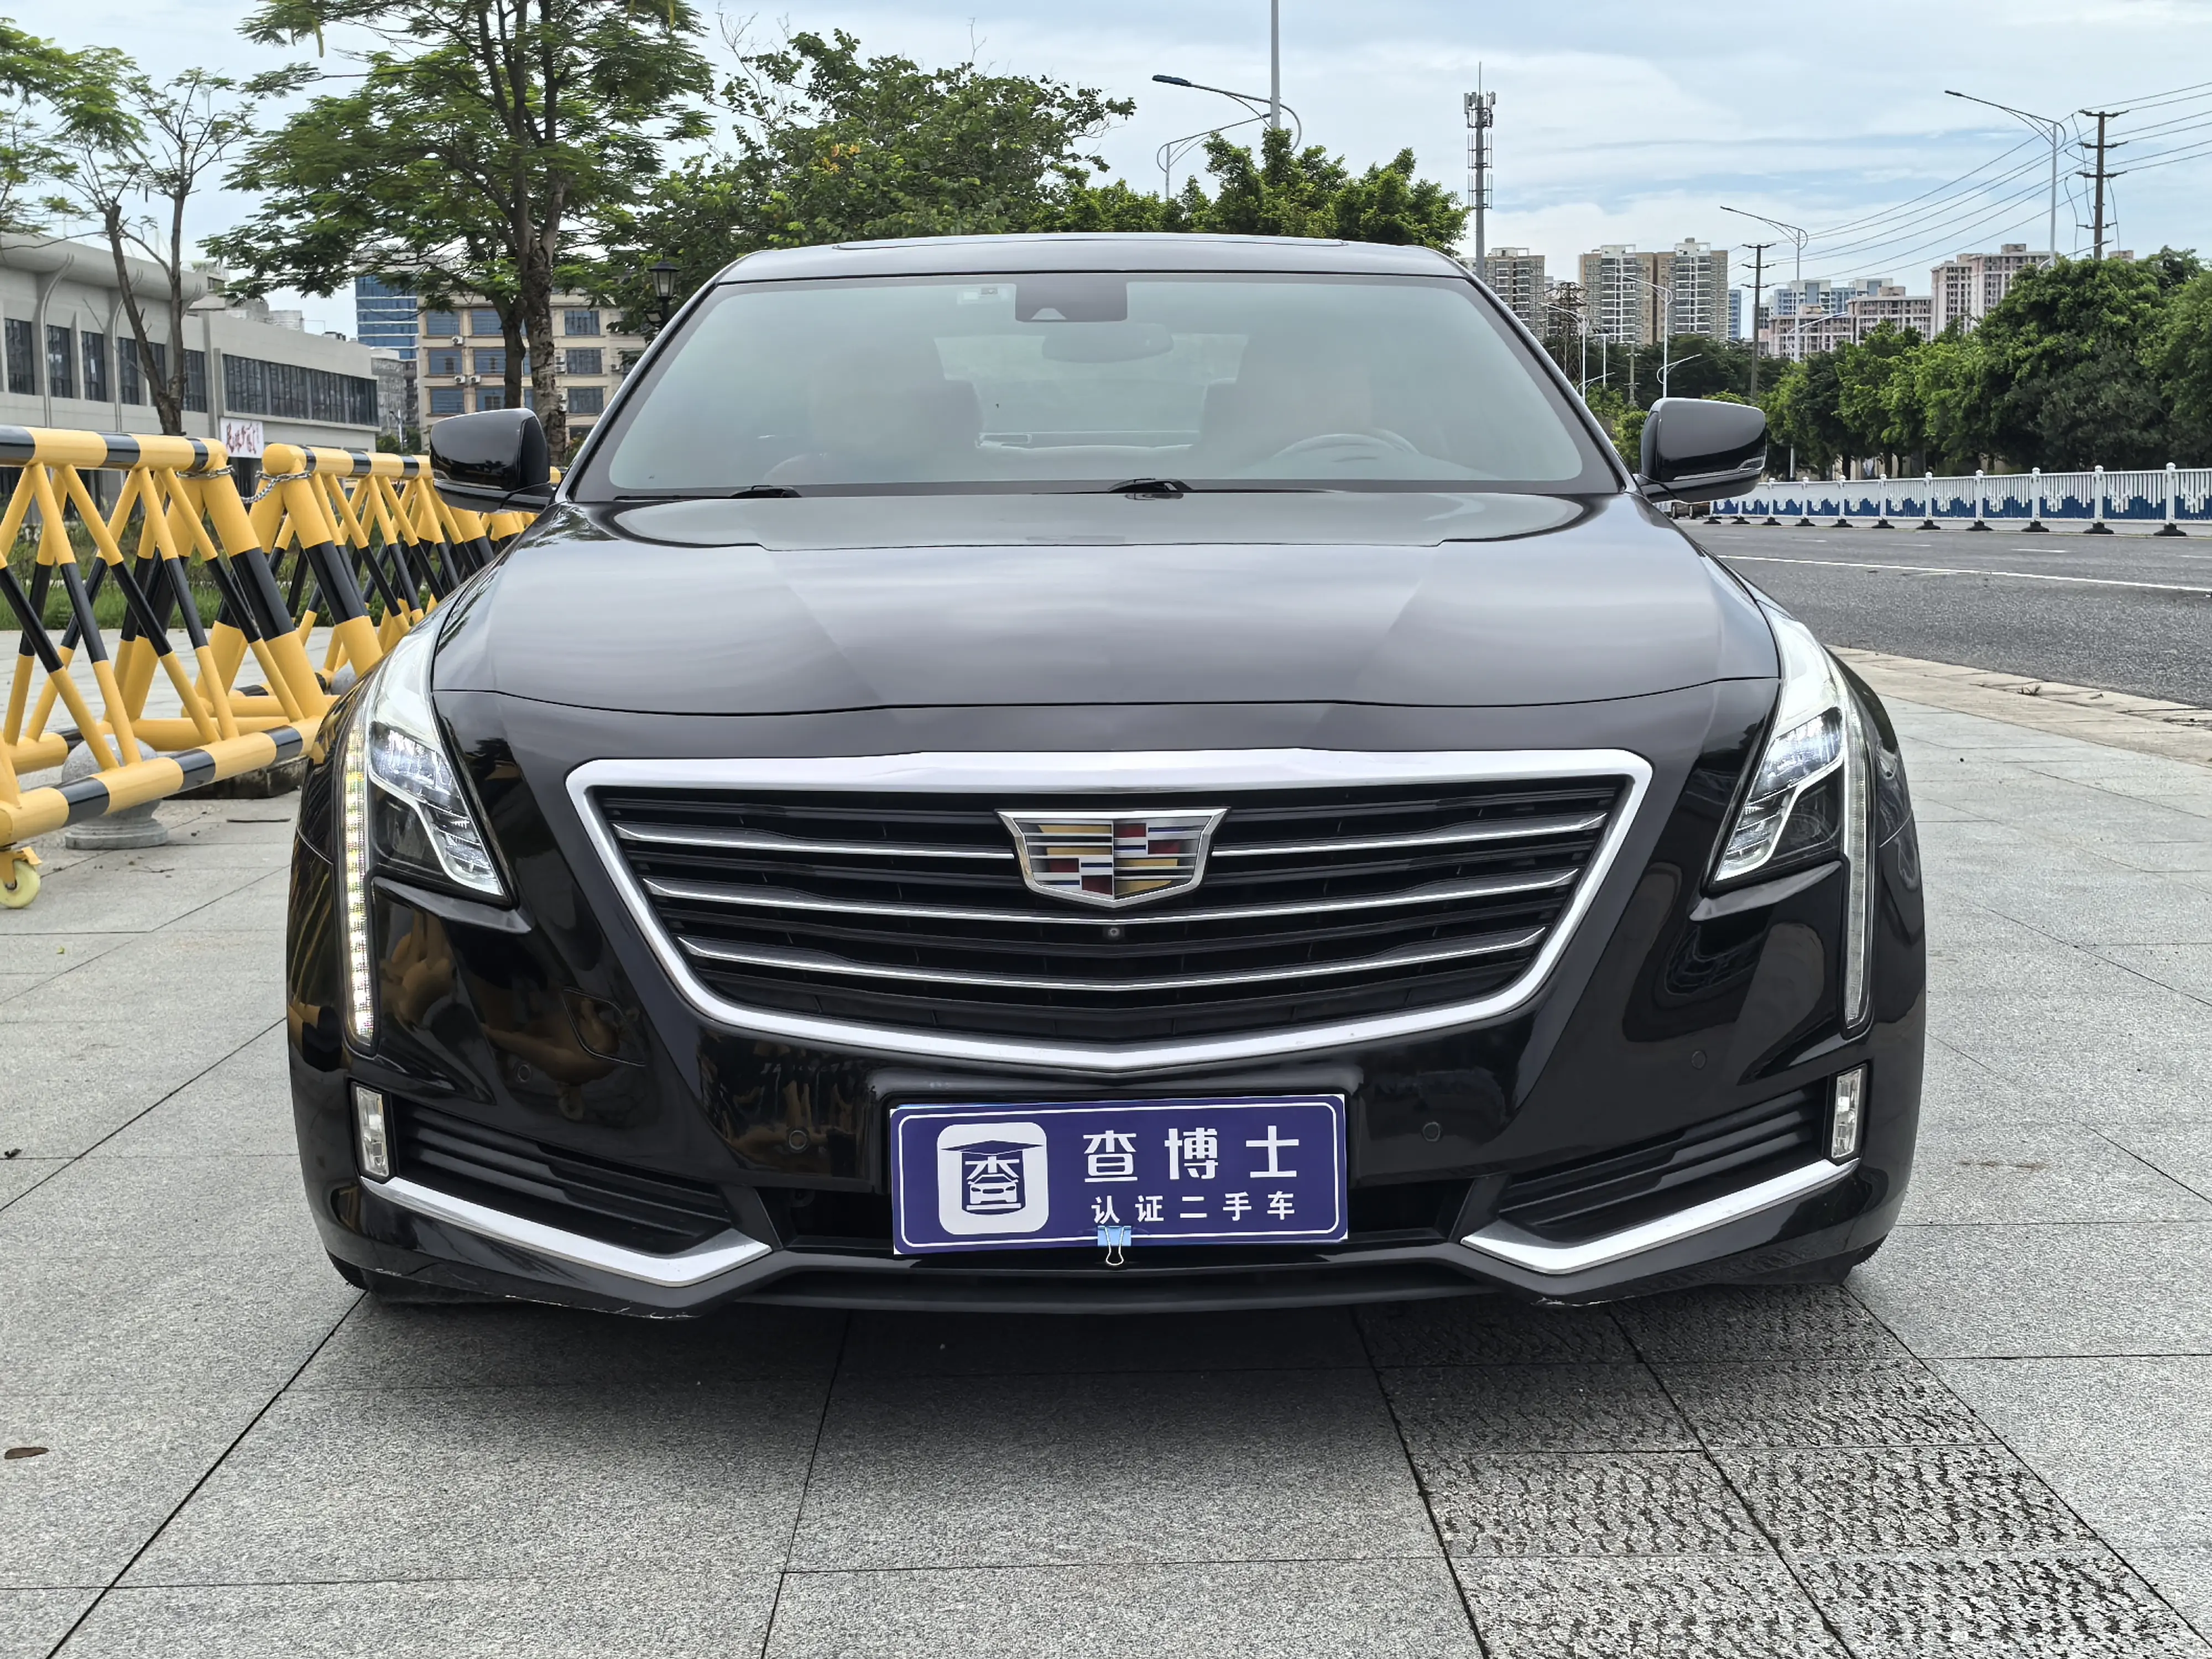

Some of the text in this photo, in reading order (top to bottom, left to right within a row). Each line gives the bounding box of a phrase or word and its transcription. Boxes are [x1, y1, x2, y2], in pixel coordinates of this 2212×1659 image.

[1083, 1125, 1300, 1183] 查博士
[1091, 1191, 1295, 1224] 认证二手车
